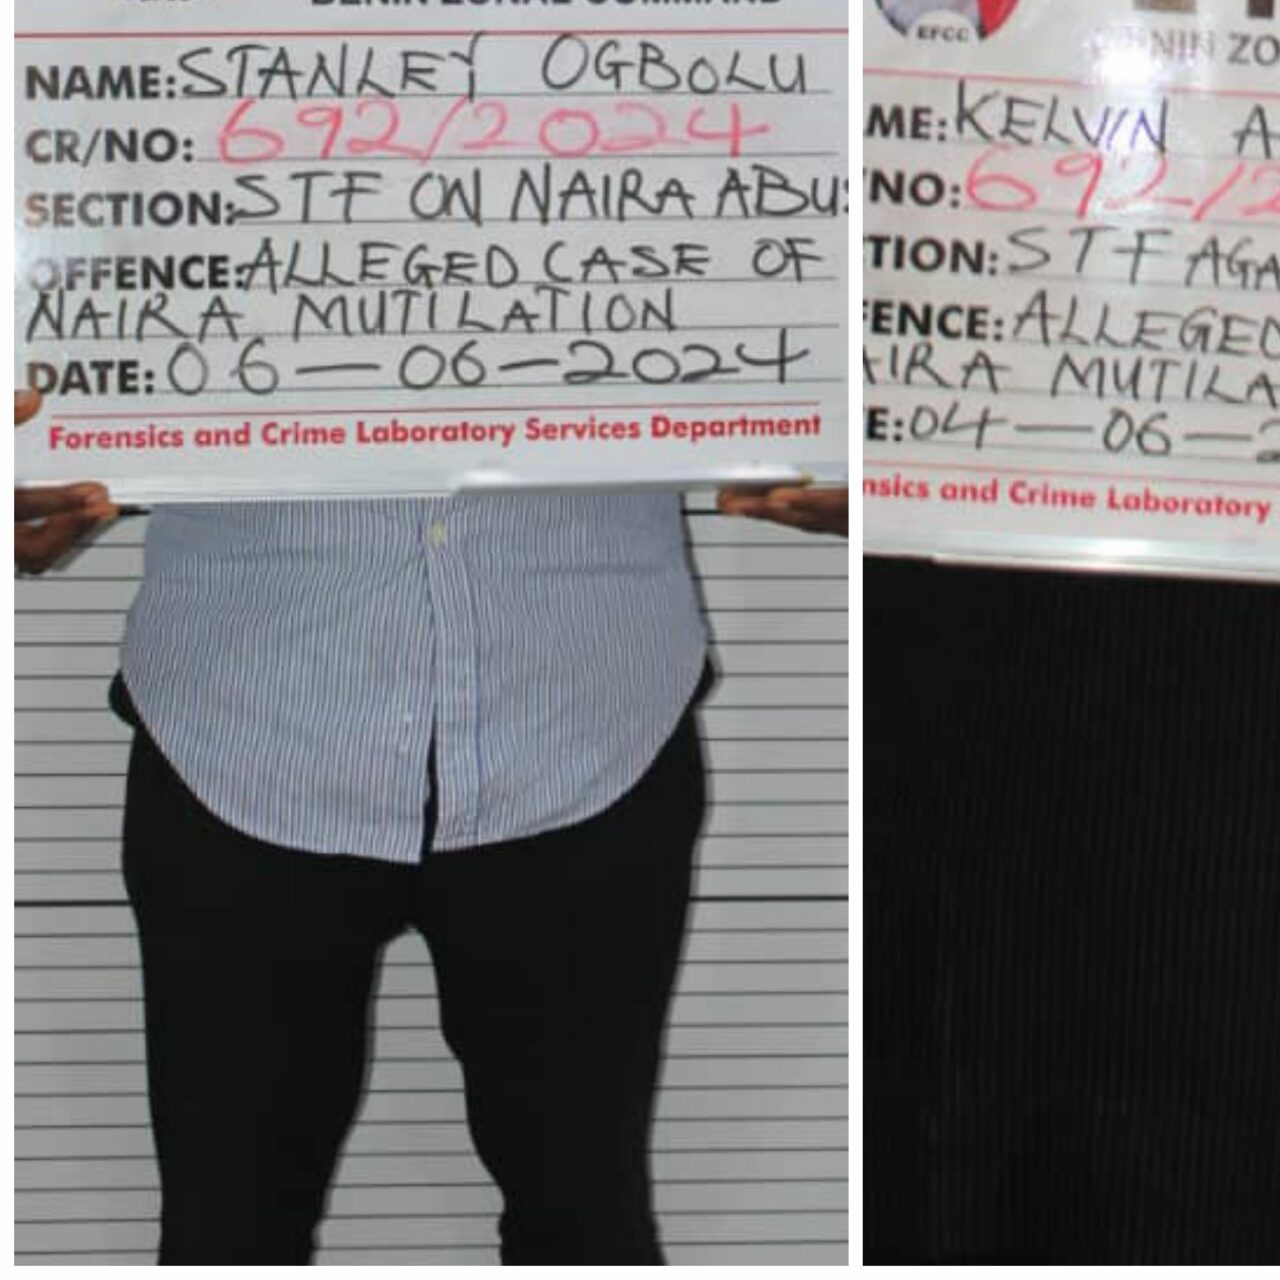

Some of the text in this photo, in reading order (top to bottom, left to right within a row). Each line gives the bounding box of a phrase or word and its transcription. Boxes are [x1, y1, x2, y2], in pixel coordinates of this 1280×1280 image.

[917, 23, 969, 42] EFCC
[25, 32, 806, 103] NAME: STANLEY OGBOLU
[25, 94, 770, 167] CR/NO: 692/2024
[955, 78, 1169, 153] KELVIN
[25, 162, 848, 227] SECTION: STF ON NAIRA ABU
[28, 236, 824, 294] OFFENCE: ALLEGED CASE OF
[1007, 225, 1172, 285] STF
[26, 286, 677, 343] NAIRA MUTILATION
[863, 299, 1003, 341] ENCE:
[26, 359, 154, 395] DATE:
[48, 414, 822, 450] Forensics and Crime Laboratory Services Department
[940, 477, 999, 503] and
[1008, 479, 1097, 508] Crime
[1107, 486, 1270, 524] Laboratory
